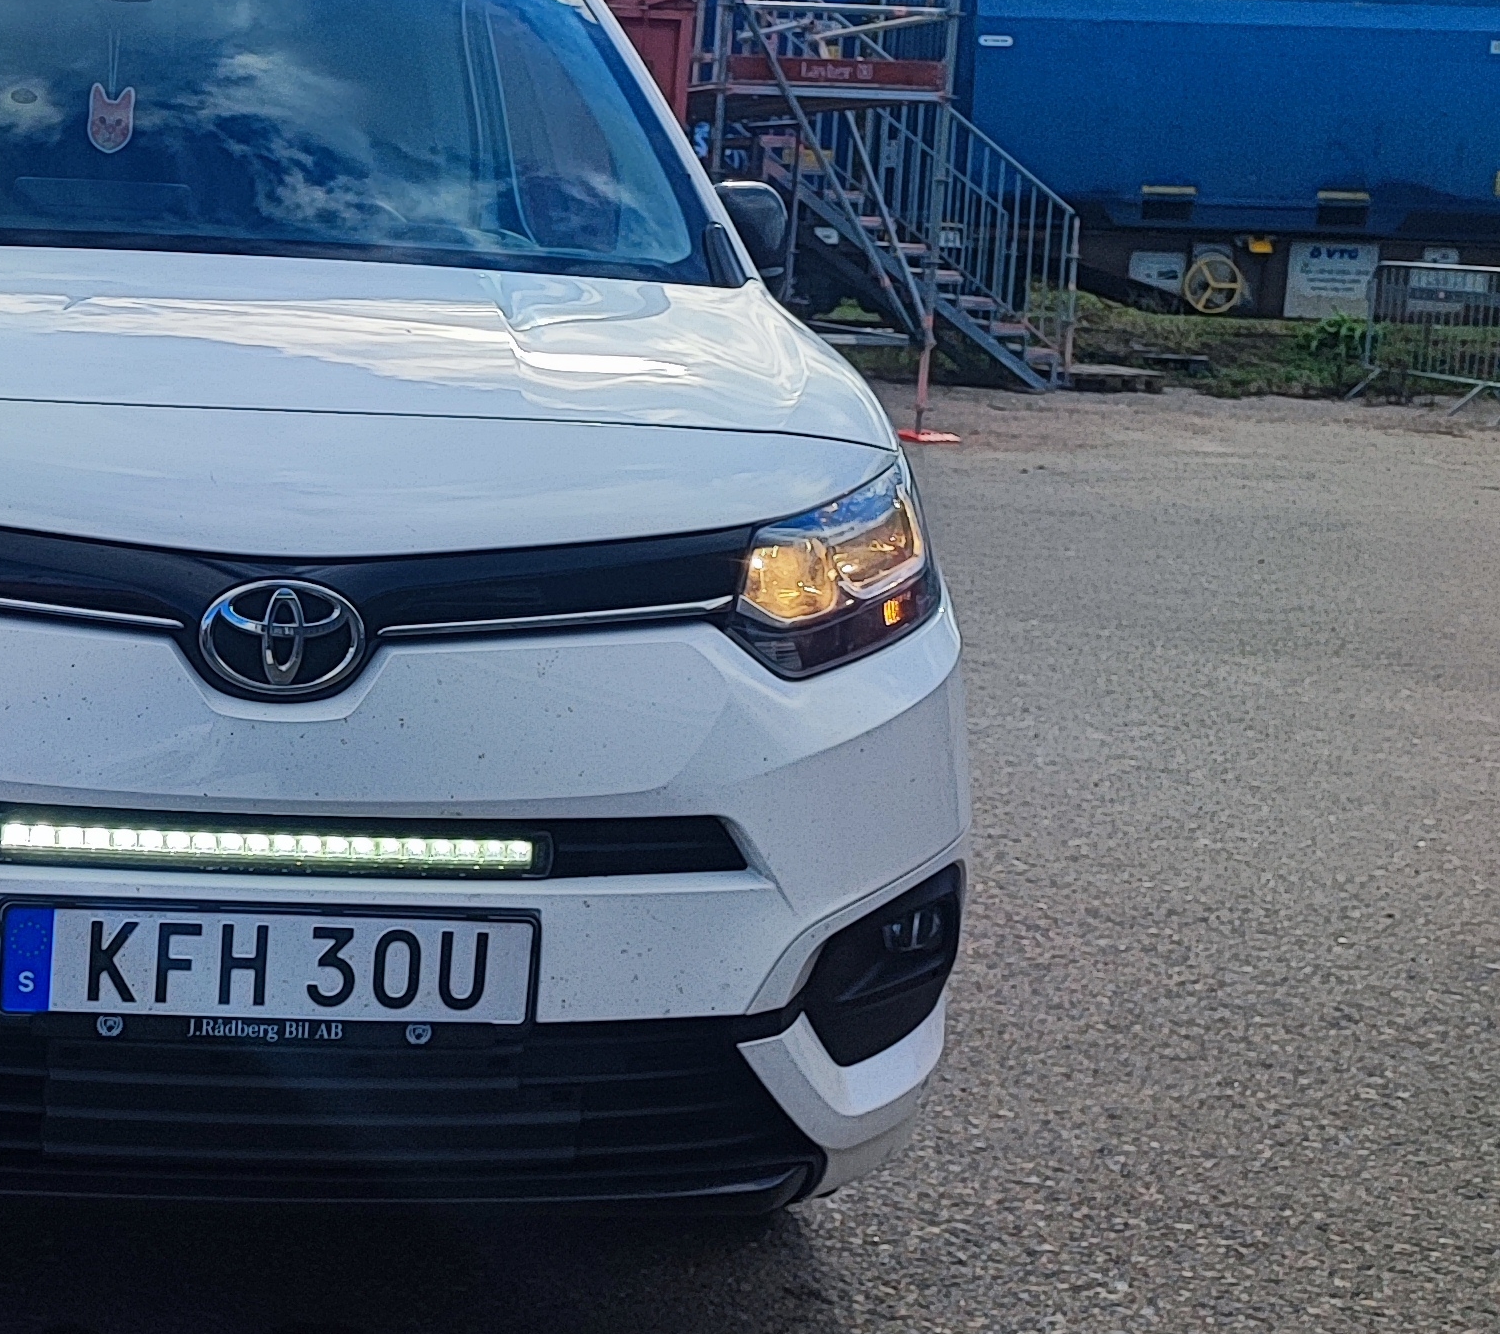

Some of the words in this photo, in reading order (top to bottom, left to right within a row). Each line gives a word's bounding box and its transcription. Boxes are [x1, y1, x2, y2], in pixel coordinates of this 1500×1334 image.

[86, 919, 270, 1007] KFH
[305, 925, 490, 1011] 30U
[17, 970, 35, 993] S
[186, 1018, 279, 1042] J.Rådberg
[284, 1021, 310, 1039] Bil
[314, 1022, 344, 1040] AB
